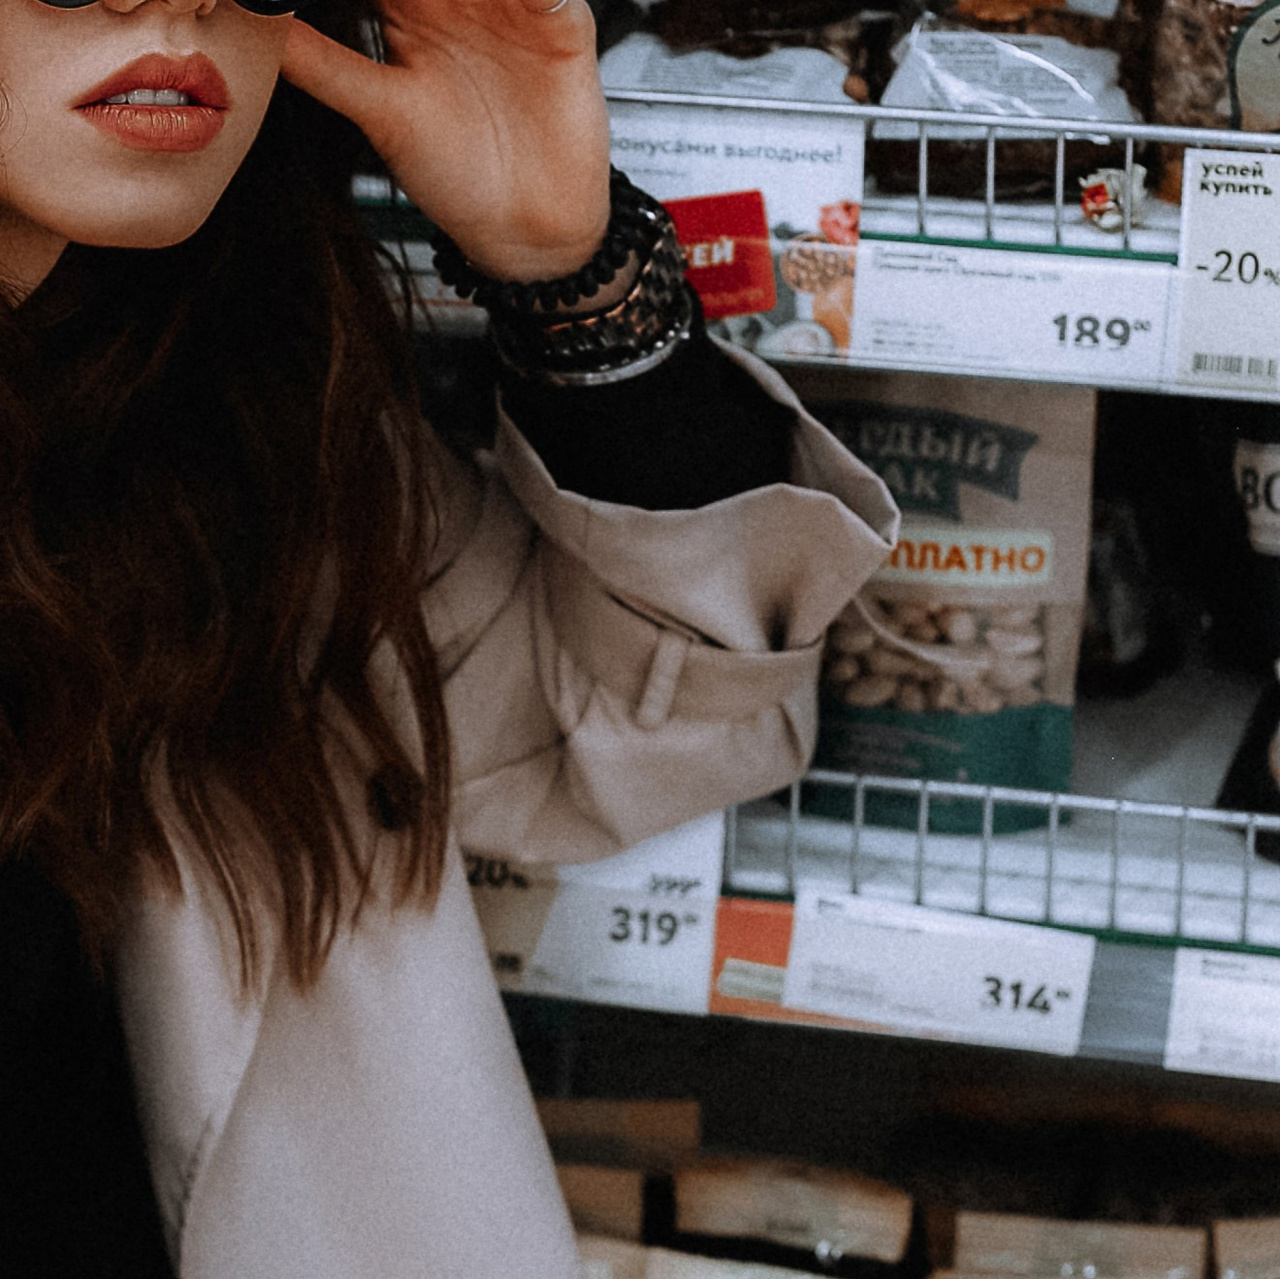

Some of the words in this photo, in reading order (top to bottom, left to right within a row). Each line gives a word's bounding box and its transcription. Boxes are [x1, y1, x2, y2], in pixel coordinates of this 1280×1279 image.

[1201, 160, 1264, 181] успей
[1199, 181, 1273, 198] купить
[1052, 312, 1131, 350] 189
[888, 538, 1047, 575] ПЛАТНО
[609, 906, 679, 947] 319
